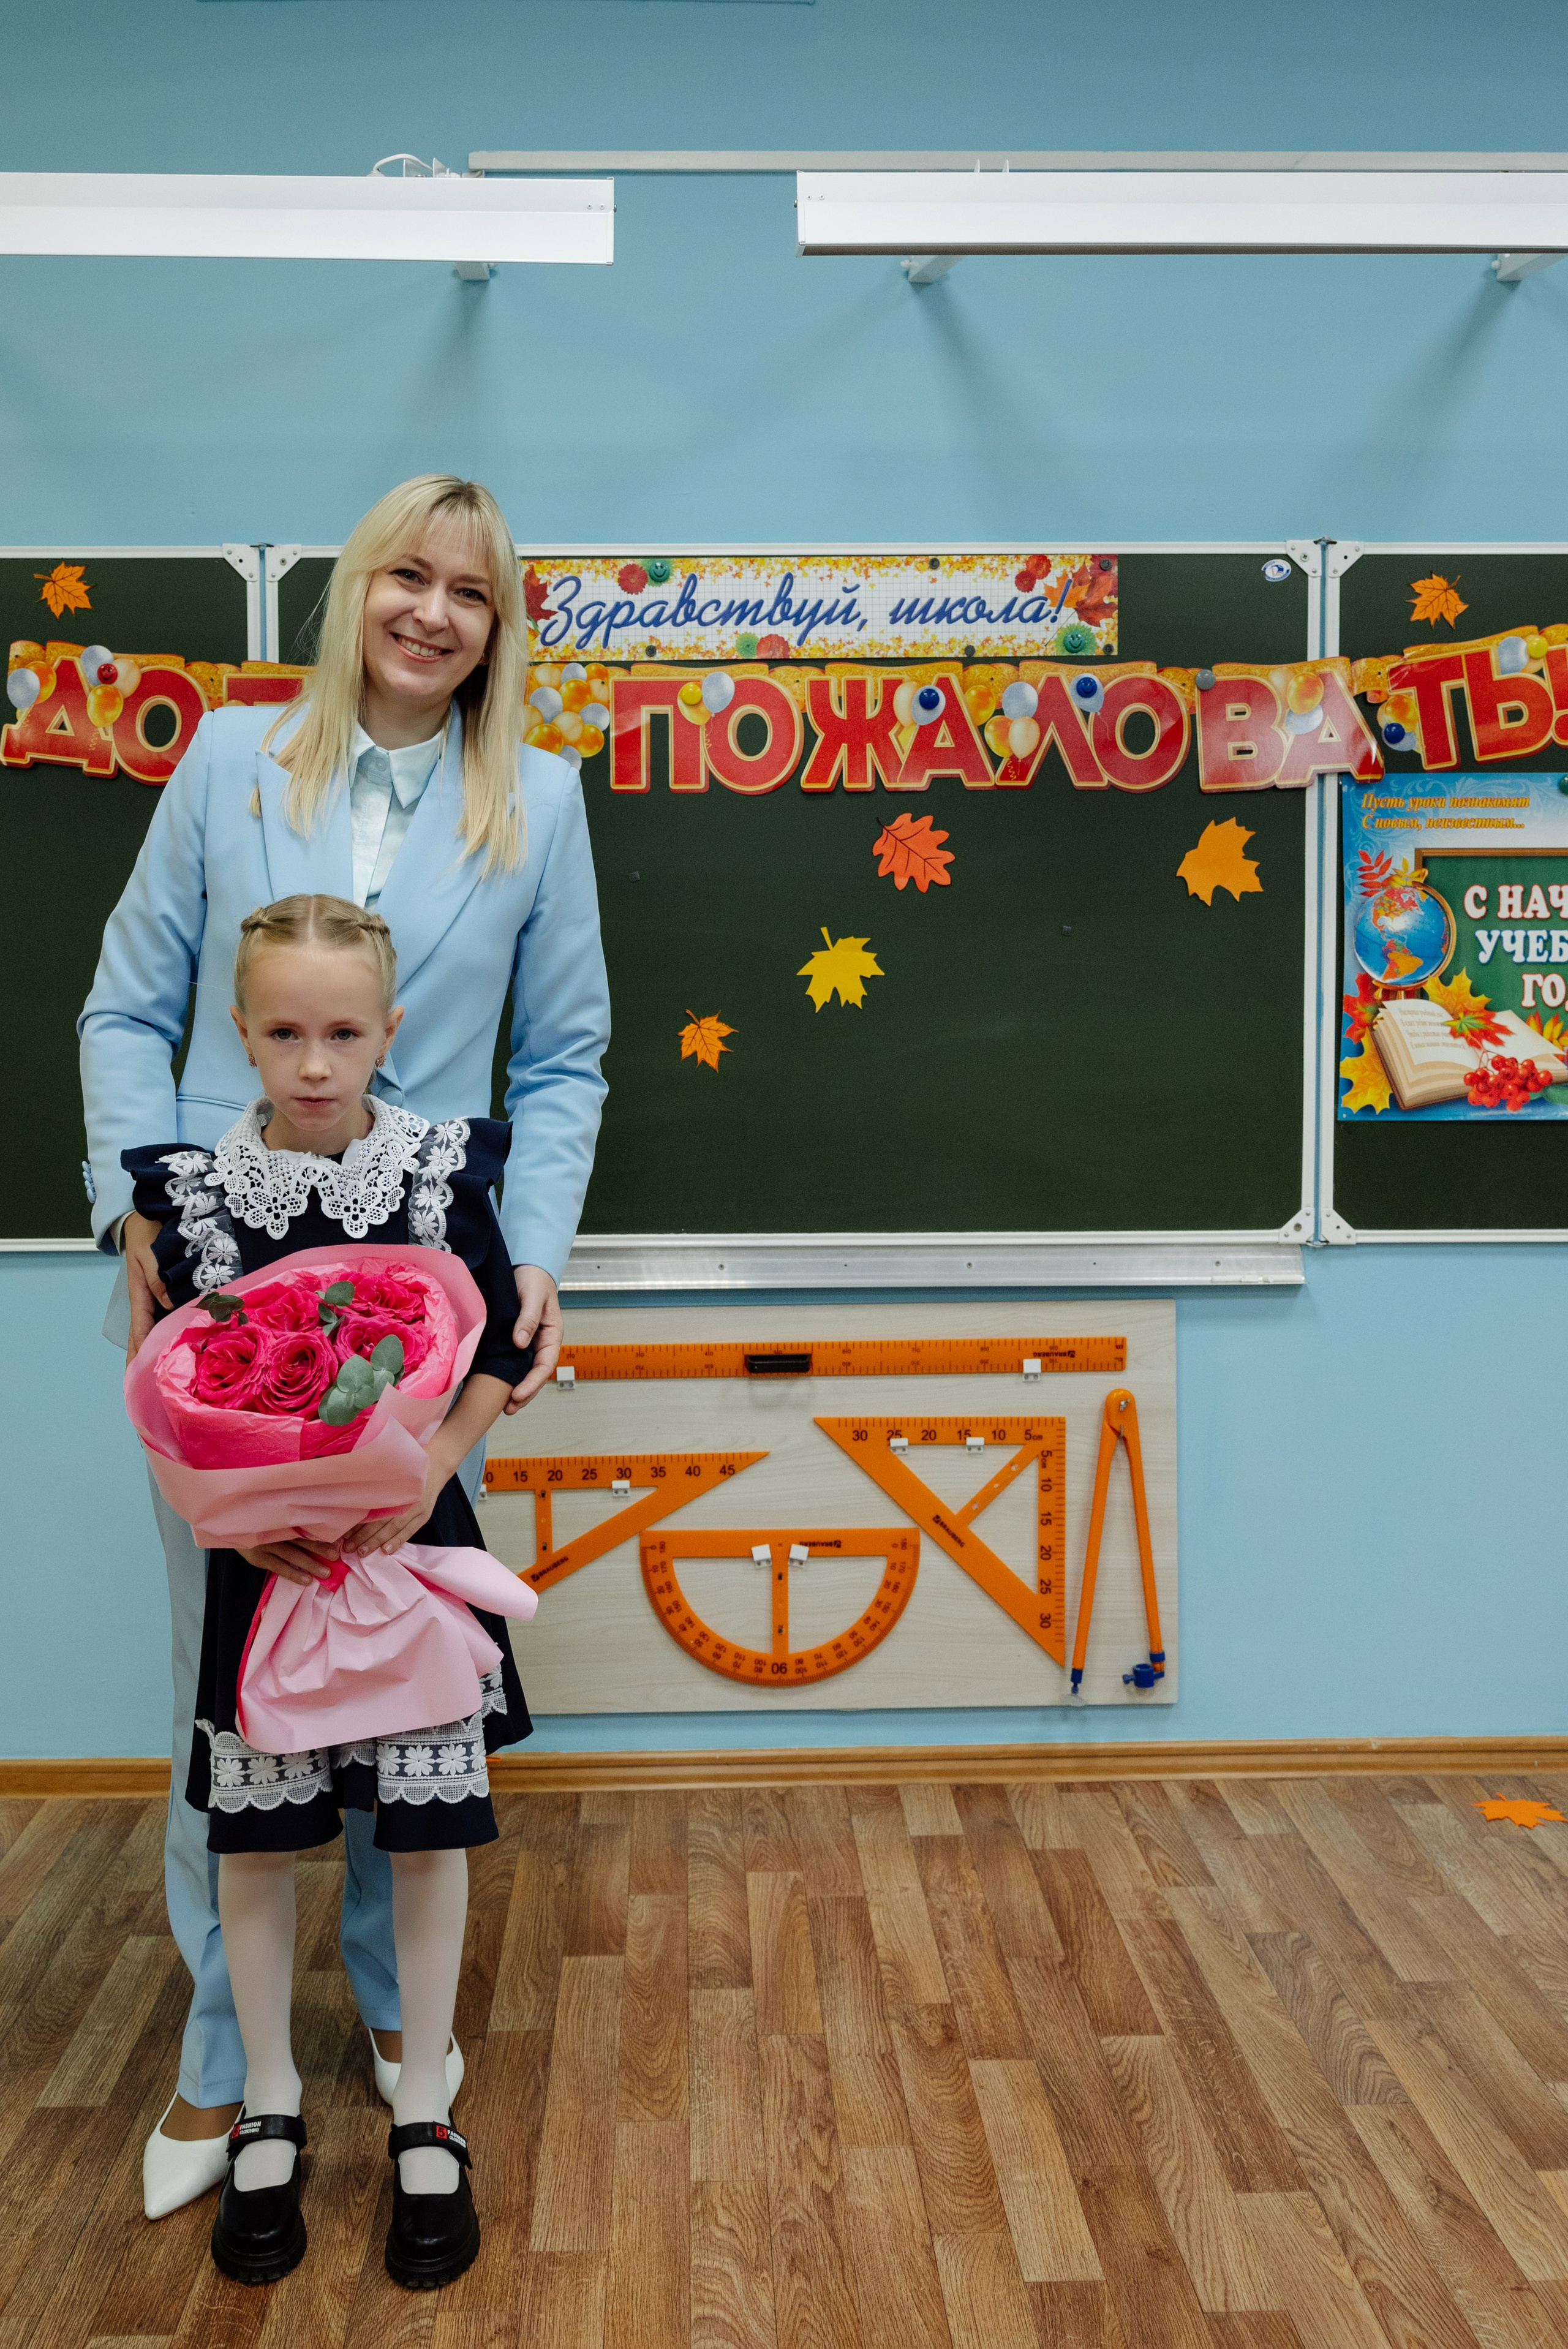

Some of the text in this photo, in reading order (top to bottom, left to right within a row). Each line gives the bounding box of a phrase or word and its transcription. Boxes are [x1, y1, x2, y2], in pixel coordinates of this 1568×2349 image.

[540, 571, 1072, 650] Здравствуй, школа!
[1361, 793, 1530, 812] Пусть уроки познакомят
[1362, 813, 1373, 829] С
[1374, 818, 1422, 831] новым,
[1463, 883, 1488, 919] С
[1521, 973, 1568, 1012] ГО
[852, 1430, 868, 1441] 30
[887, 1430, 902, 1441] 25
[921, 1430, 937, 1441] 20
[957, 1430, 971, 1440] 15
[991, 1430, 1006, 1441] 10
[513, 1471, 528, 1482] 15
[548, 1469, 563, 1481] 20
[581, 1468, 597, 1480] 25
[616, 1467, 631, 1479] 30
[650, 1466, 666, 1477] 35
[685, 1465, 701, 1477] 40
[719, 1465, 735, 1476] 45
[1041, 1477, 1052, 1491] 10
[1041, 1512, 1052, 1526] 15
[1040, 1545, 1052, 1561] 20
[1040, 1578, 1052, 1594] 25
[1039, 1613, 1052, 1629] 30
[771, 1662, 788, 1675] 90
[239, 2121, 262, 2130] FASHION
[437, 2127, 445, 2137] 5
